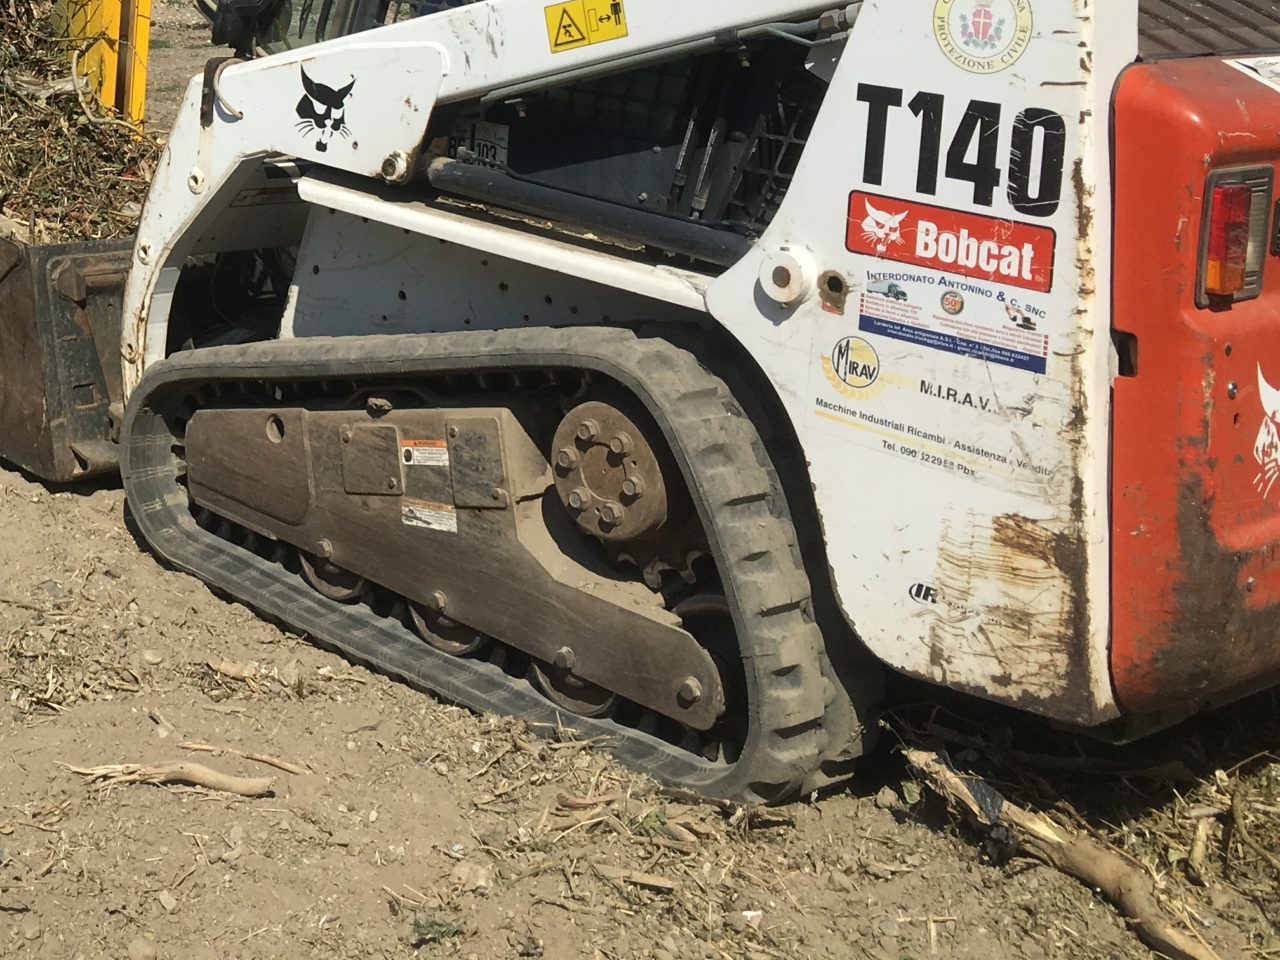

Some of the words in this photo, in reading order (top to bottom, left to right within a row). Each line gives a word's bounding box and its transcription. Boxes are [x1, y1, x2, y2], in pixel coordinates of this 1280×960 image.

[937, 16, 995, 70] PROTEZIONE
[1000, 26, 1028, 64] CIVILE
[856, 83, 1066, 217] T140
[916, 219, 1034, 280] Bobcat
[867, 270, 935, 285] INTERDONATO
[938, 276, 992, 298] ANTONINO
[996, 291, 1006, 303] &
[1025, 304, 1046, 319] SNC
[836, 339, 876, 382] MIRAV
[920, 379, 991, 413] M.I.R.A.V.
[815, 397, 857, 417] Macchine
[859, 411, 905, 432] Industriali
[907, 425, 946, 445] Ricambi
[953, 440, 1007, 464] Assistenza
[900, 445, 917, 458] 090
